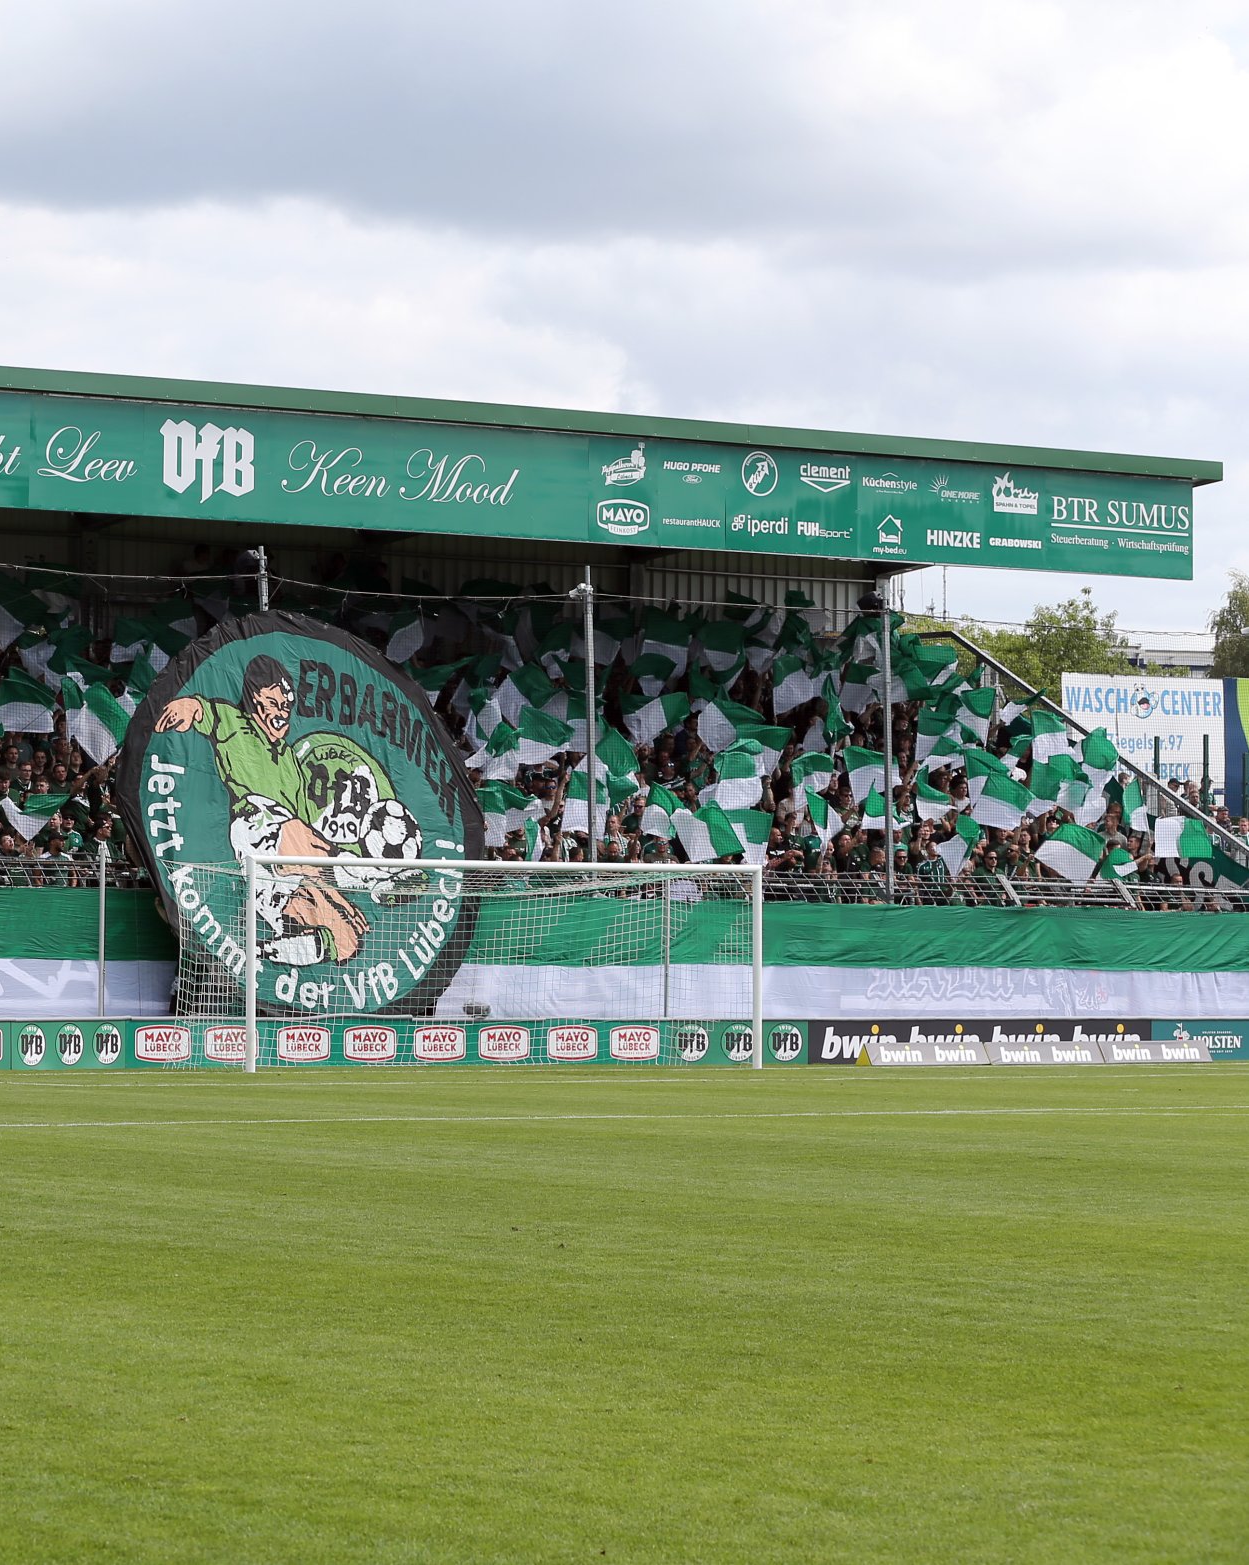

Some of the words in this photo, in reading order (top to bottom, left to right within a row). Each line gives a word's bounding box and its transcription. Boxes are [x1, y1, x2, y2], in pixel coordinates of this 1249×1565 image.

[37, 426, 138, 483] Leev
[159, 418, 255, 504] VfB
[281, 440, 391, 498] Keen
[399, 448, 520, 506] Mood
[663, 460, 690, 471] HUGO
[690, 462, 722, 474] PFOHE
[862, 476, 918, 492] Küchenstyle
[995, 501, 1014, 509] SPAHN
[1051, 496, 1100, 523] BTR
[1107, 500, 1189, 530] SUMUS
[602, 506, 645, 524] MAYO
[662, 517, 721, 528] restaurantHAUCK
[610, 525, 637, 534] FEINKOST
[747, 515, 789, 537] iperdi
[926, 529, 981, 549] HINZKE
[989, 537, 1042, 550] GRABOWSKI
[1051, 533, 1109, 550] Steuerberatung
[1117, 537, 1190, 555] Wirtschaftsprüfung
[872, 546, 907, 555] my-bed.eu
[1065, 686, 1129, 714] WASCH
[1161, 689, 1223, 717] CENTER
[321, 815, 358, 839] 1919
[147, 754, 185, 857] Jetzt
[275, 968, 336, 1009] der
[343, 962, 399, 1010] VfB
[21, 1033, 43, 1056] VfB
[59, 1033, 81, 1056] VfB
[96, 1032, 119, 1056] VfB
[145, 1032, 181, 1042] MAYO
[286, 1032, 321, 1042] MAYO
[353, 1032, 387, 1042] MAYO
[423, 1032, 457, 1042] MAYO
[487, 1031, 521, 1042] MAYO
[555, 1032, 589, 1042] MAYO
[618, 1032, 651, 1042] MAYO
[678, 1032, 706, 1053] VfB
[725, 1032, 753, 1053] VfB
[772, 1032, 801, 1053] VfB
[880, 1046, 922, 1062] bwin
[934, 1045, 977, 1062] bwin
[1000, 1046, 1041, 1062] bwin
[1052, 1045, 1092, 1062] bwin
[1112, 1044, 1151, 1061] bwin
[1161, 1043, 1200, 1060] bwin
